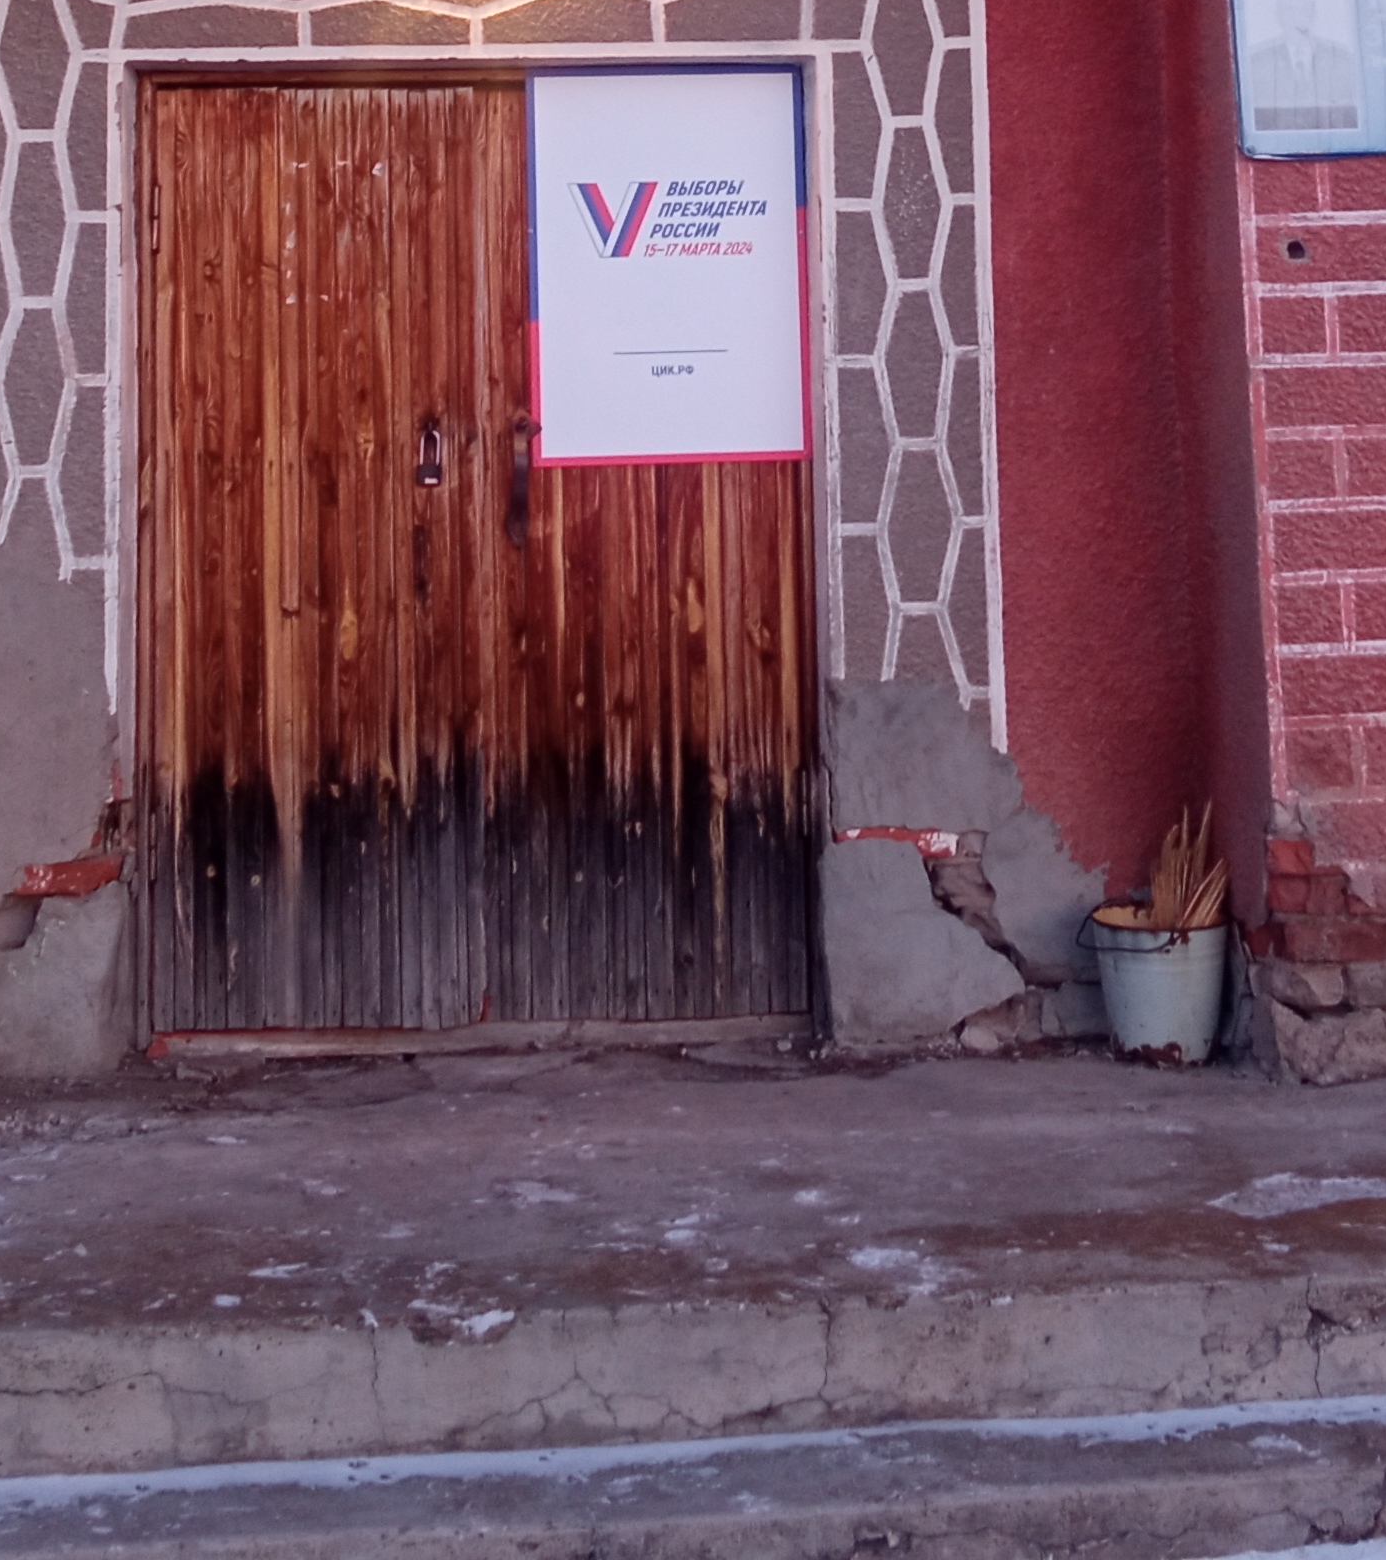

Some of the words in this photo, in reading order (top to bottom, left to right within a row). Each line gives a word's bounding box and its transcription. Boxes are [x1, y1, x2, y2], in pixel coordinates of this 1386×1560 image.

[666, 180, 745, 197] ВЫБОРЫ
[657, 200, 767, 219] ПРЕЗИДЕНТА
[649, 222, 721, 239] РОССИИ
[679, 242, 721, 257] МАРТА
[723, 241, 754, 256] 2024
[651, 363, 695, 377] ЦИК.РФ
